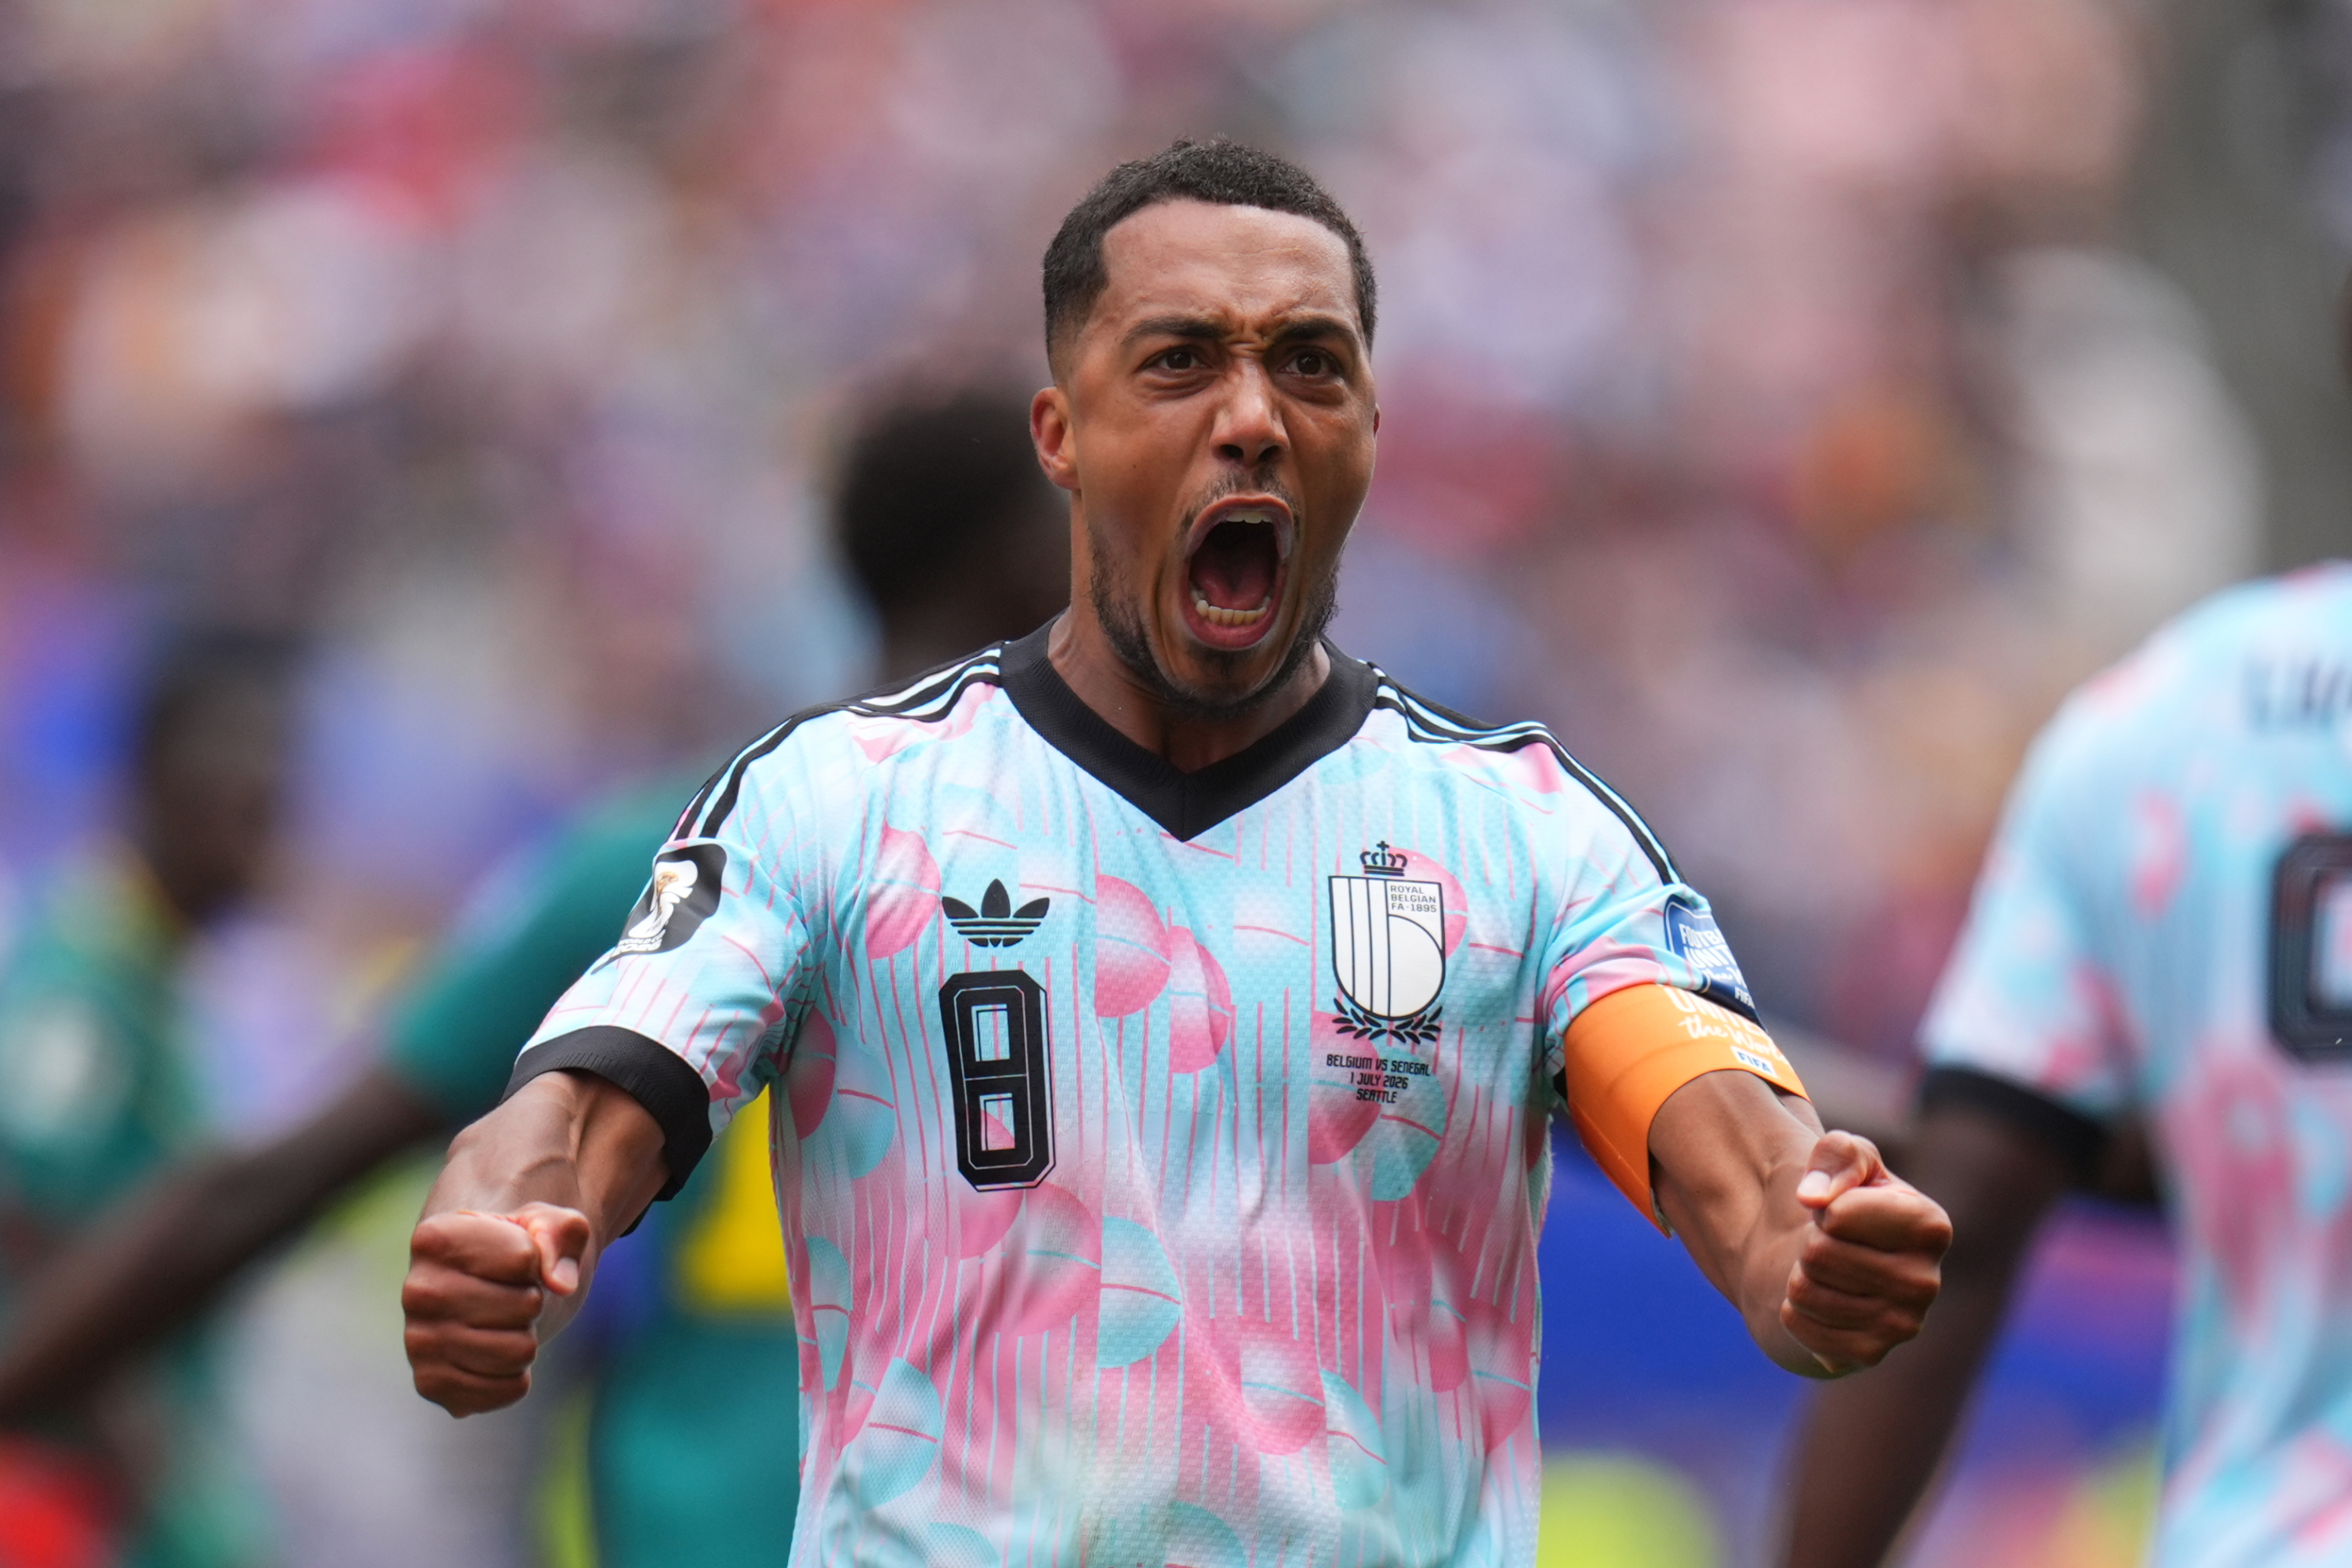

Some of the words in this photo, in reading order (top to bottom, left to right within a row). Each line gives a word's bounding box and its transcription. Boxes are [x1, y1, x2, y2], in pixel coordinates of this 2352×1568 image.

[1390, 884, 1425, 895] ROYAL
[1391, 893, 1436, 903] BELGIAN
[1392, 902, 1405, 911] FA
[1410, 903, 1437, 913] 1895
[1677, 1014, 1729, 1040] the
[1327, 1054, 1373, 1070] BELGIUM
[1374, 1058, 1388, 1072] VS
[1390, 1060, 1431, 1077] SENEGAL
[1737, 1051, 1773, 1075] FIFA
[938, 969, 1057, 1192] 8
[1349, 1071, 1355, 1084] 1
[1356, 1073, 1381, 1087] JULY
[1383, 1075, 1410, 1090] 2026
[1356, 1087, 1398, 1104] SEATTLE
